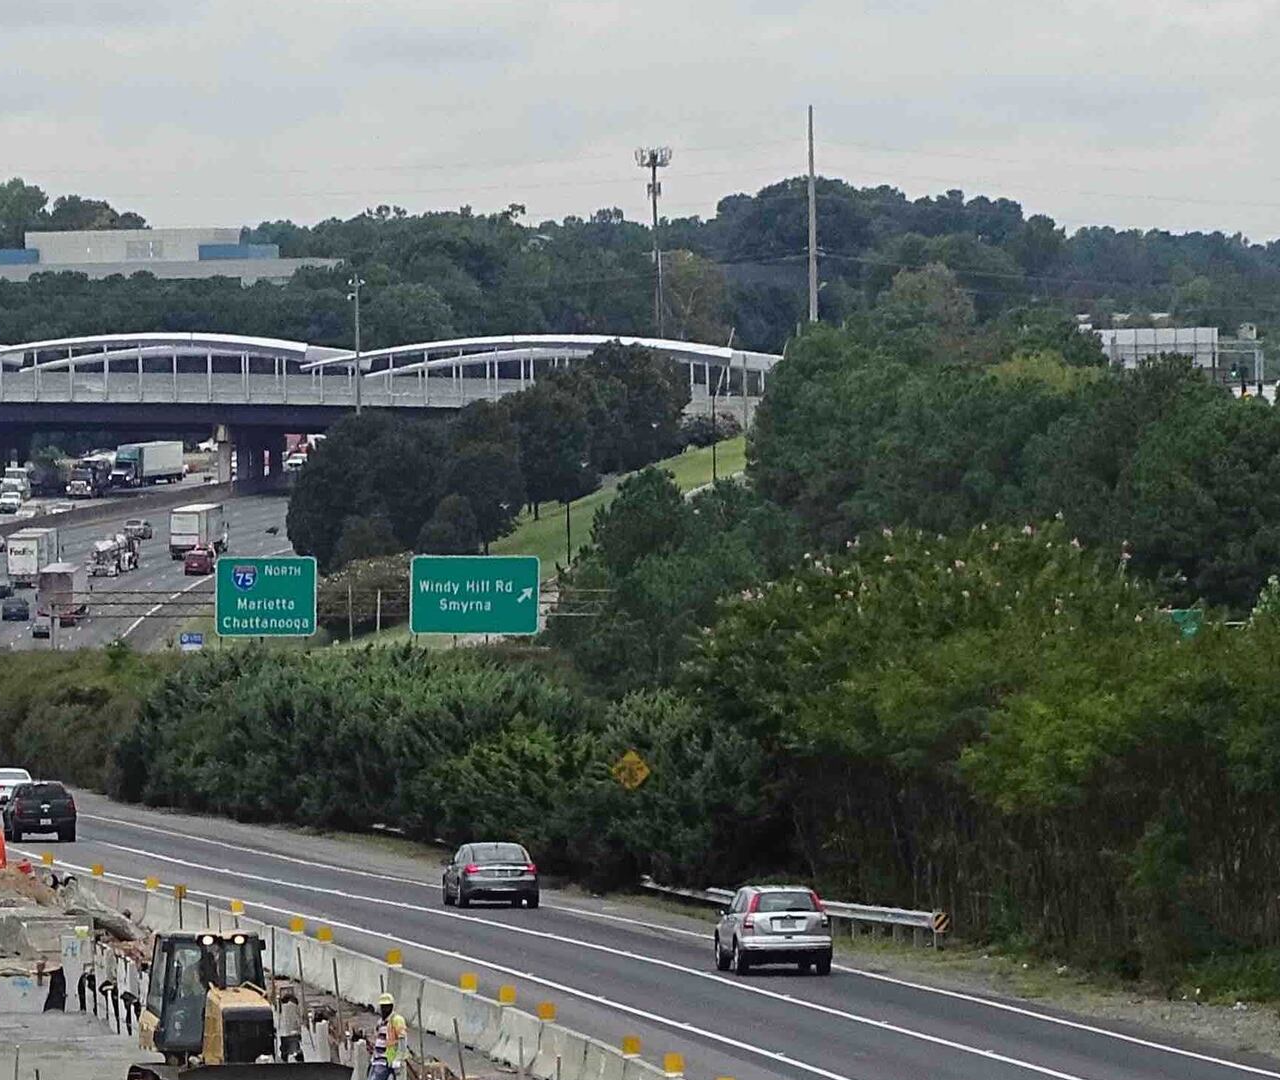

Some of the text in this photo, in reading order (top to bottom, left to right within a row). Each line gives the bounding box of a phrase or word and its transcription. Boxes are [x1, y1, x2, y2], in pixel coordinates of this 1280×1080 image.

[235, 573, 254, 586] 75
[264, 565, 301, 576] NORTH
[419, 580, 513, 595] Windy Hill Rd
[237, 598, 295, 610] Marietta
[439, 599, 491, 614] Smyrna
[223, 616, 309, 632] Chattanooga
